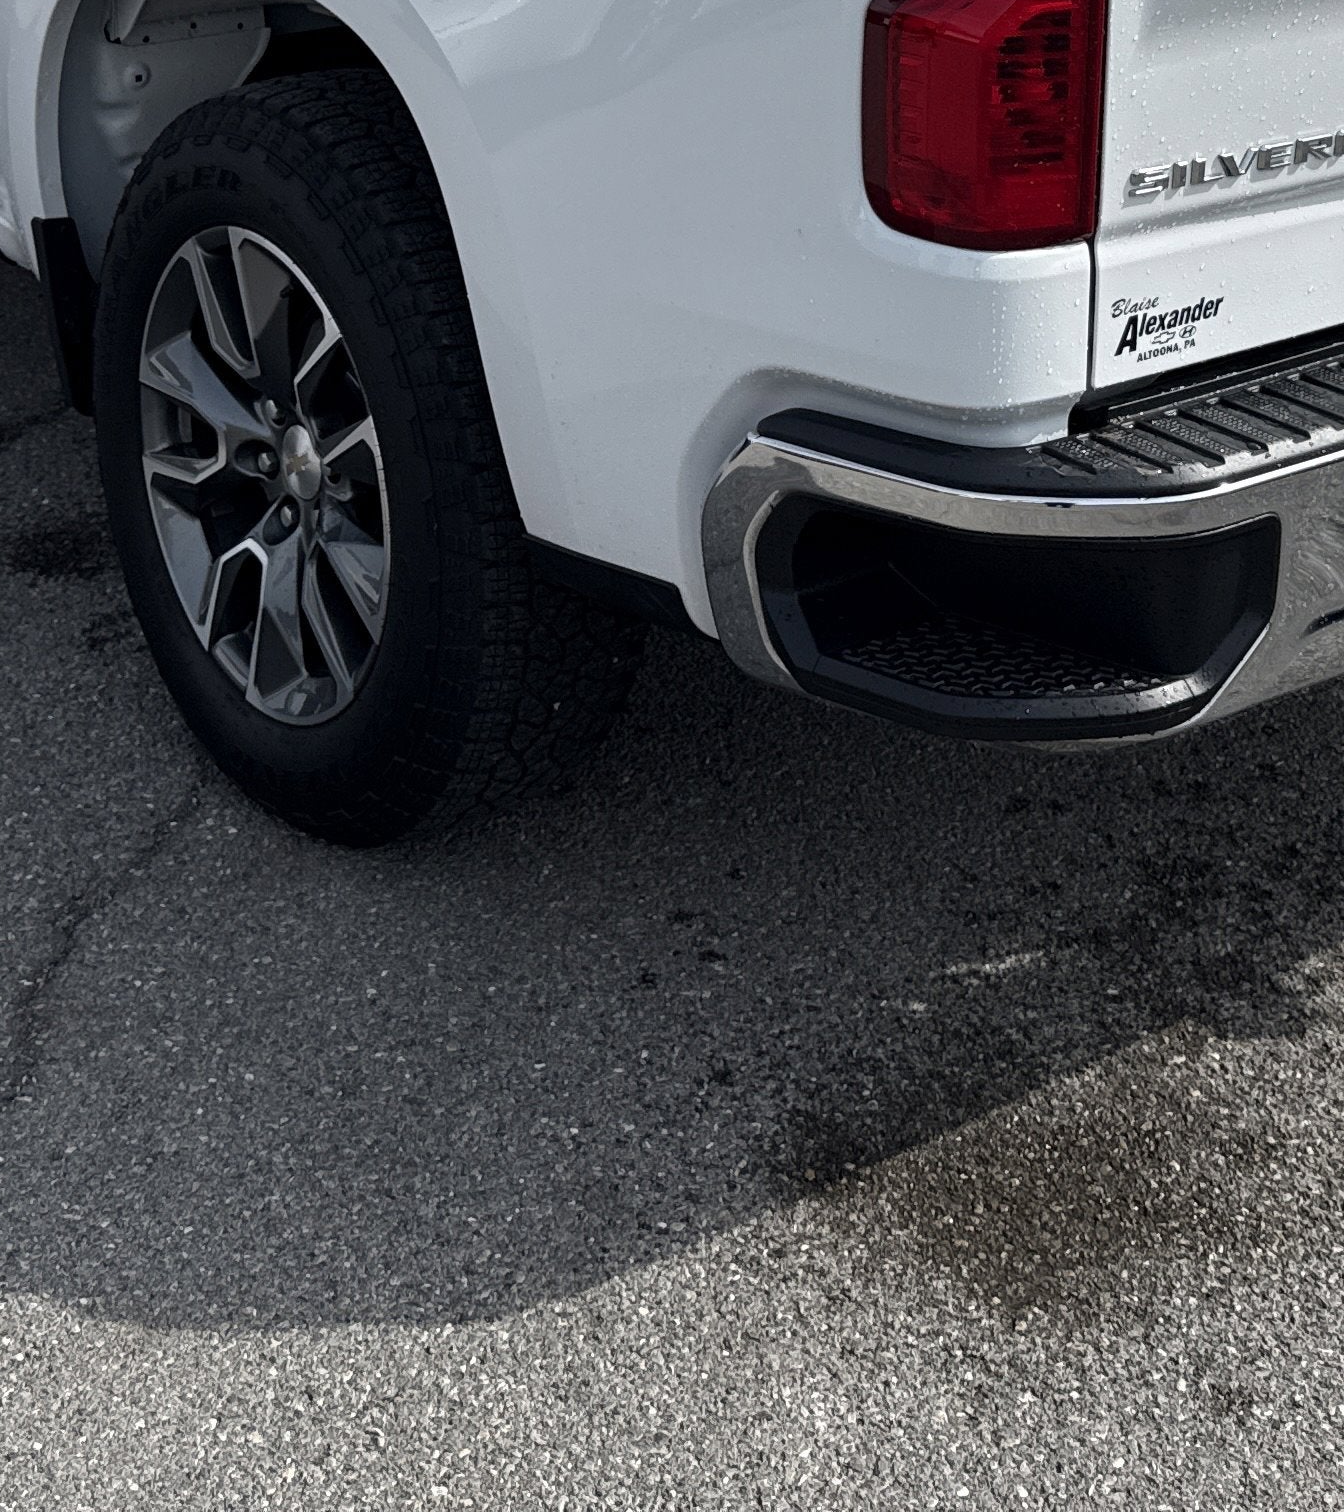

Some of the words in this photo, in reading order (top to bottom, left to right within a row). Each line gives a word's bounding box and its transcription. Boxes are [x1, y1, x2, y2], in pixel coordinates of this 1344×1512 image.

[1111, 296, 1160, 318] Blaise
[1114, 296, 1225, 357] Alexander
[1136, 343, 1182, 362] ALTOONA,
[1183, 338, 1196, 350] PA
